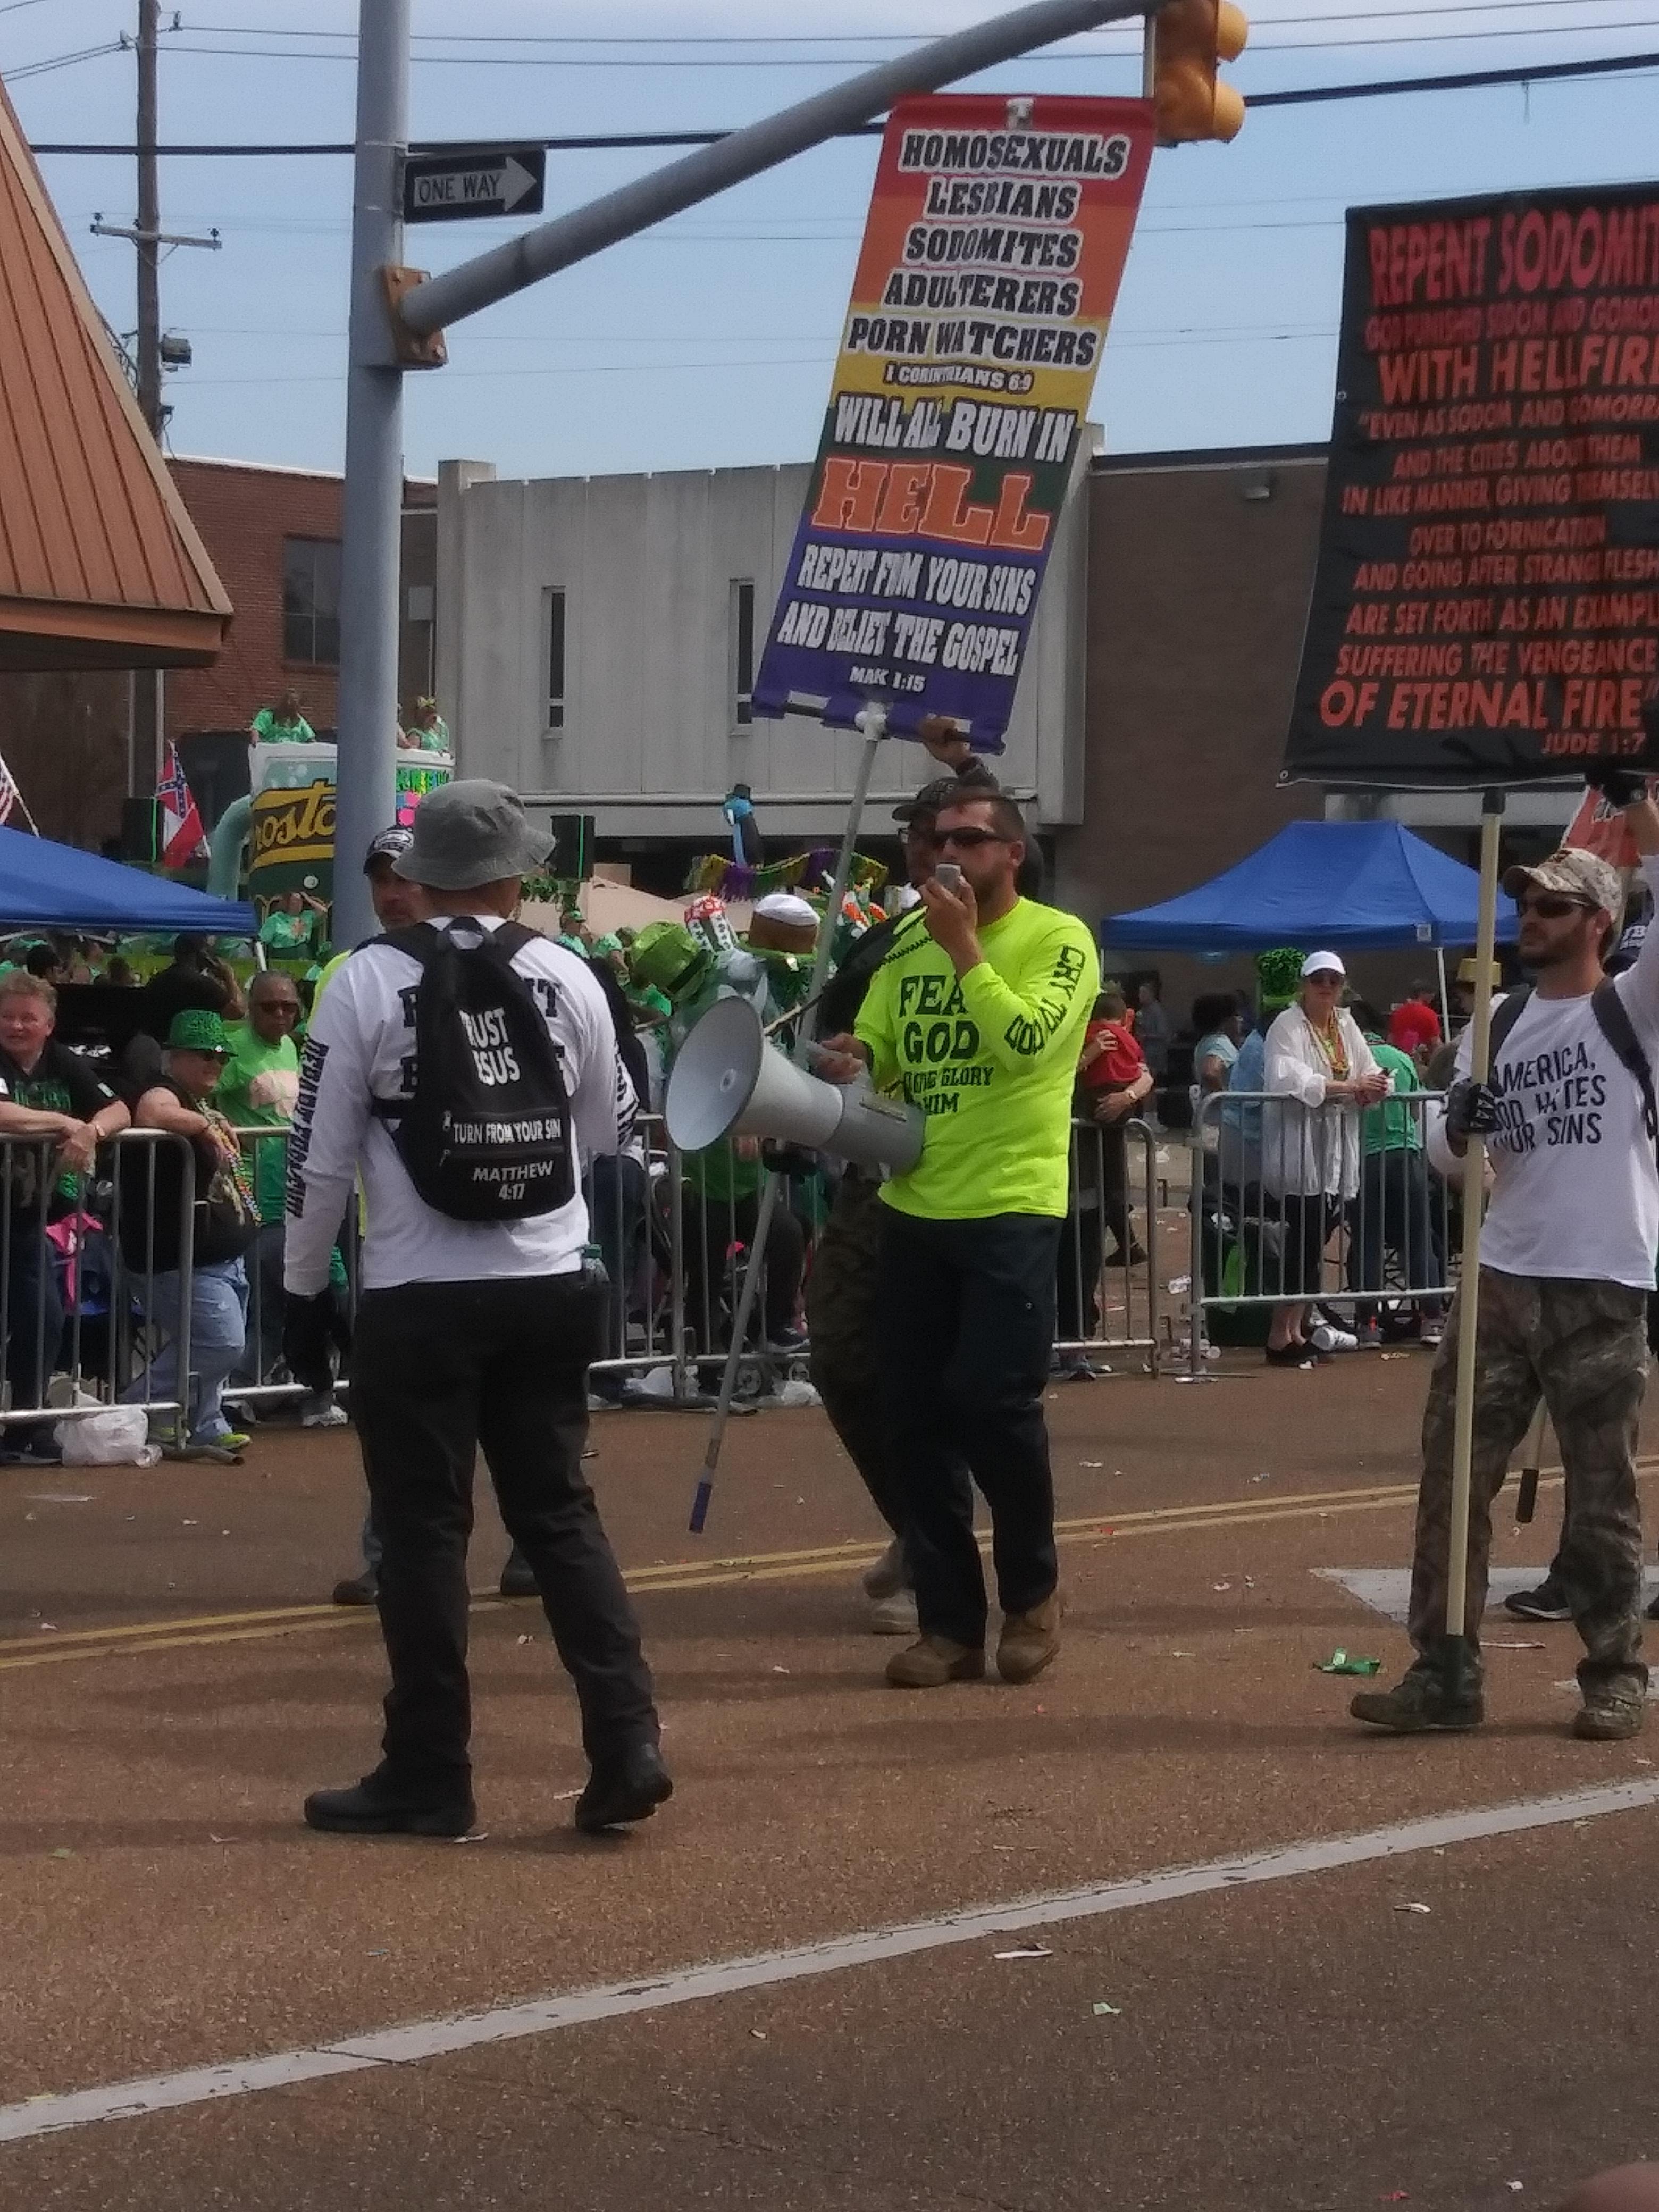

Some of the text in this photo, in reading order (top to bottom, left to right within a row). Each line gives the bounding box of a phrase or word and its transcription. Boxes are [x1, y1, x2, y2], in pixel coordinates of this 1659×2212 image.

[903, 133, 1126, 174] HOMOSEXUALS
[419, 173, 500, 202] ONE WAY
[906, 226, 1078, 267] SODOMITES
[1369, 216, 1491, 307] REPENT
[884, 272, 1079, 316] ADULTERERS
[848, 317, 1097, 366] PORN WATCHERS
[1008, 373, 1032, 391] 6:9
[1379, 346, 1479, 404] WITH
[834, 395, 903, 447] WILL
[946, 401, 1036, 459] BURN
[1035, 410, 1075, 462] IN
[1519, 398, 1565, 426] AND
[1392, 449, 1431, 479] AND
[811, 457, 1052, 551] HELL
[1341, 485, 1368, 514] IN
[1495, 473, 1571, 507] GIVING
[924, 555, 988, 610] YOUR
[985, 565, 1036, 616] SINS
[1353, 562, 1398, 591] AND
[1402, 557, 1463, 589] GOING
[1345, 602, 1389, 635] ARE
[1393, 601, 1430, 635] SET
[1499, 597, 1529, 631] AS
[1534, 596, 1568, 630] AN
[777, 601, 831, 648] AND
[893, 611, 945, 664] THE
[941, 622, 1019, 676] GOSPEL
[1335, 640, 1657, 677] SUFFERING THE VENGEANCE
[892, 672, 926, 692] 1:15
[1320, 680, 1379, 727] OF
[1387, 679, 1548, 730] ETERNAL
[1541, 733, 1647, 755] JUDE 1:7
[899, 975, 968, 1018] FEA
[904, 1020, 981, 1063] GOD
[941, 1066, 994, 1086] GLORY
[1495, 1042, 1596, 1093] MERICA,
[454, 1122, 482, 1144] TURN
[486, 1122, 515, 1144] FROM
[513, 1120, 543, 1143] YOUR
[1495, 1099, 1526, 1130] OD
[1548, 1113, 1602, 1146] SINS
[473, 1160, 554, 1182] MATTHEW
